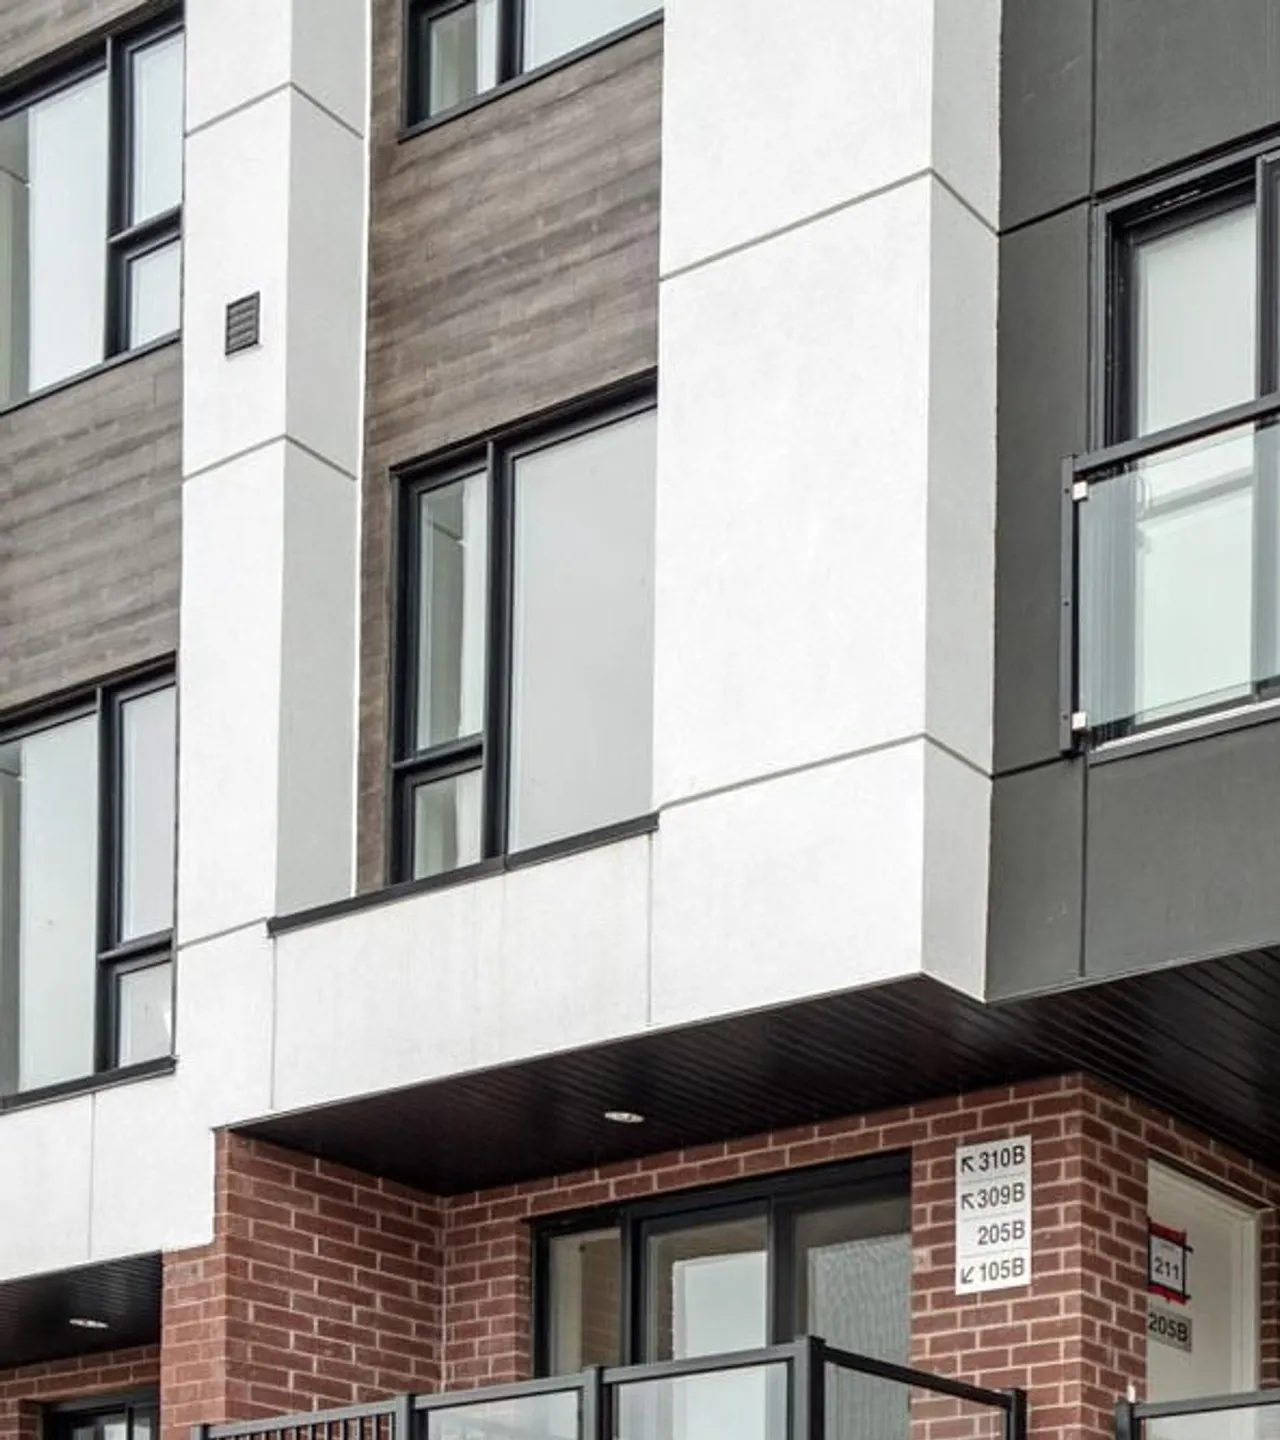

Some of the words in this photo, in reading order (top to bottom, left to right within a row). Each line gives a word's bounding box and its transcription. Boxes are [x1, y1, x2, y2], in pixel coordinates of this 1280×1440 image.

[978, 1145, 1026, 1173] 310B
[977, 1182, 1026, 1209] 309B
[977, 1220, 1026, 1246] 205B
[979, 1257, 1026, 1283] 105B
[1154, 1256, 1180, 1281] 211
[1149, 1313, 1189, 1343] 205B
